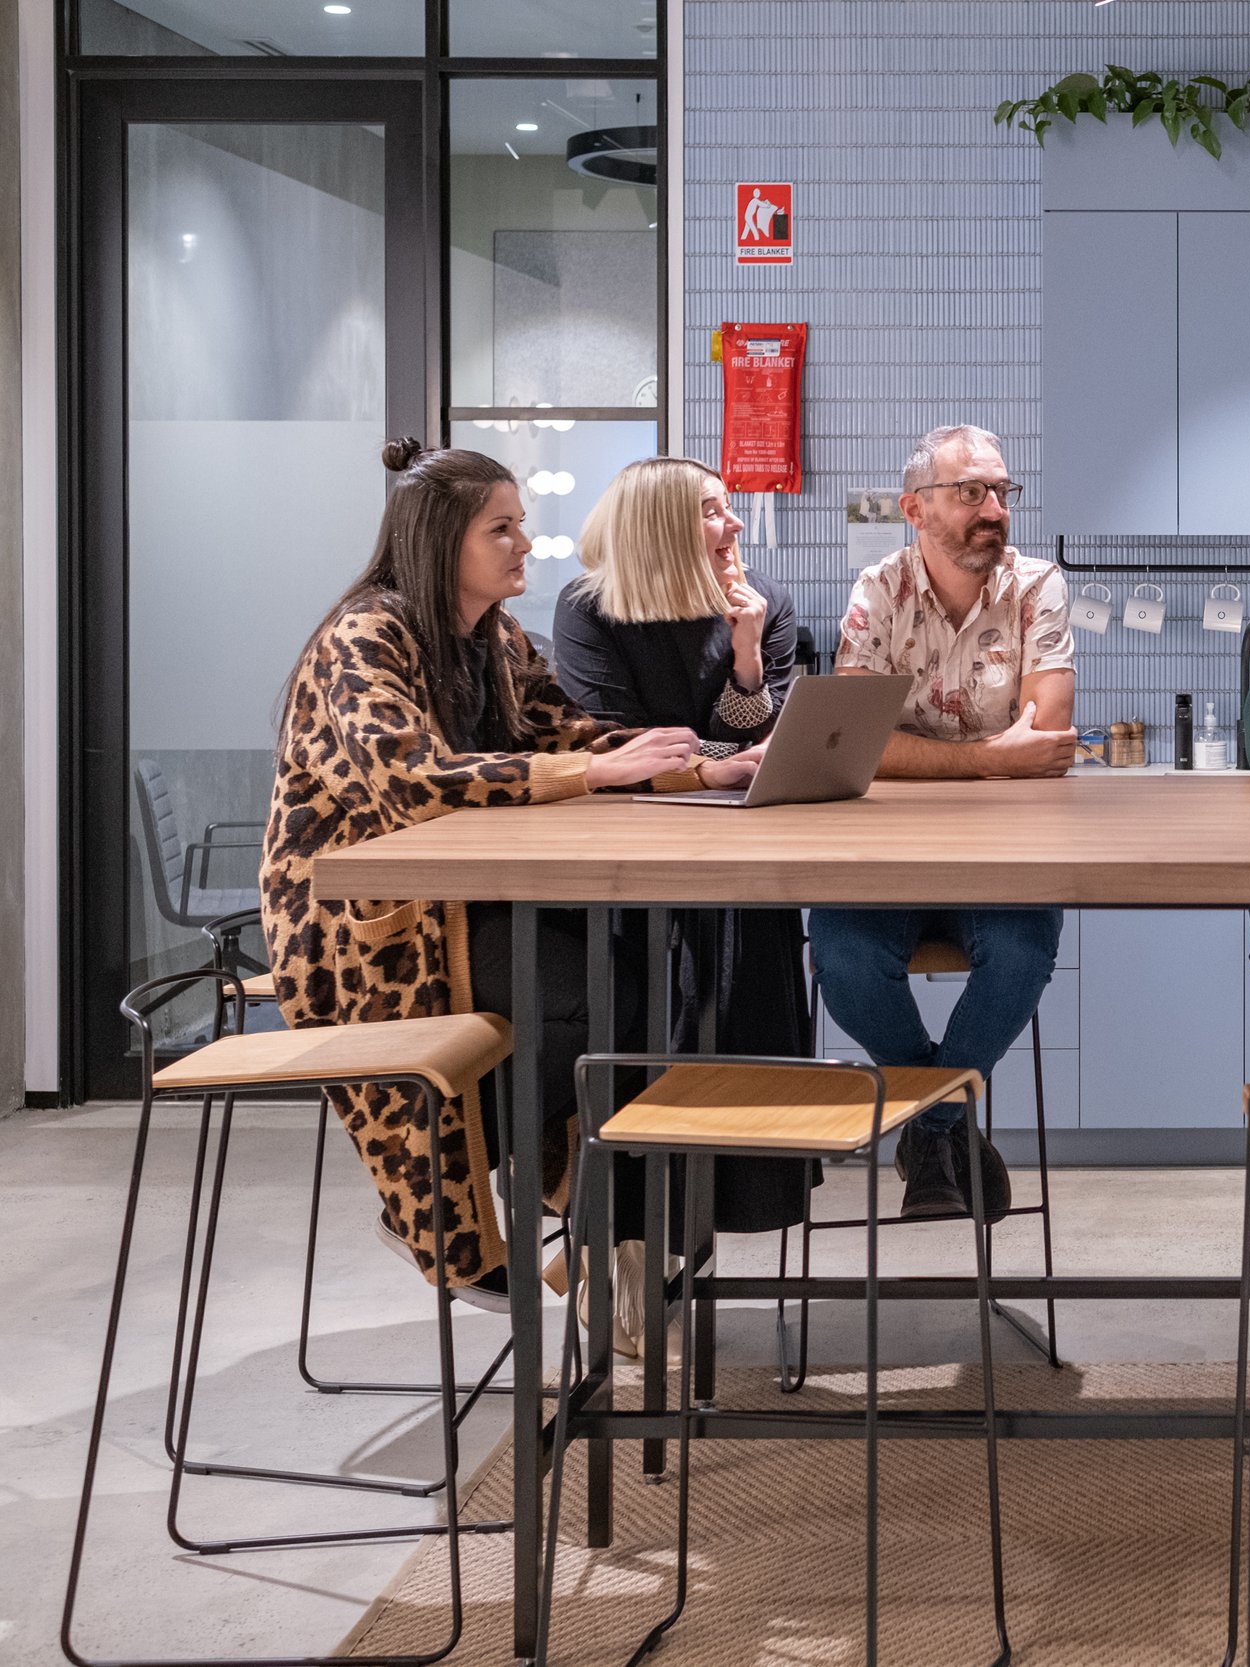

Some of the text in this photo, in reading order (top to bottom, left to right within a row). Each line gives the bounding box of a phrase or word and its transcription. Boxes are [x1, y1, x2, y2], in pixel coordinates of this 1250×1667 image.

[731, 357, 795, 368] FIRE BLANKET
[732, 464, 742, 472] PULL
[742, 464, 754, 472] DOWN
[770, 464, 788, 473] RELEASE
